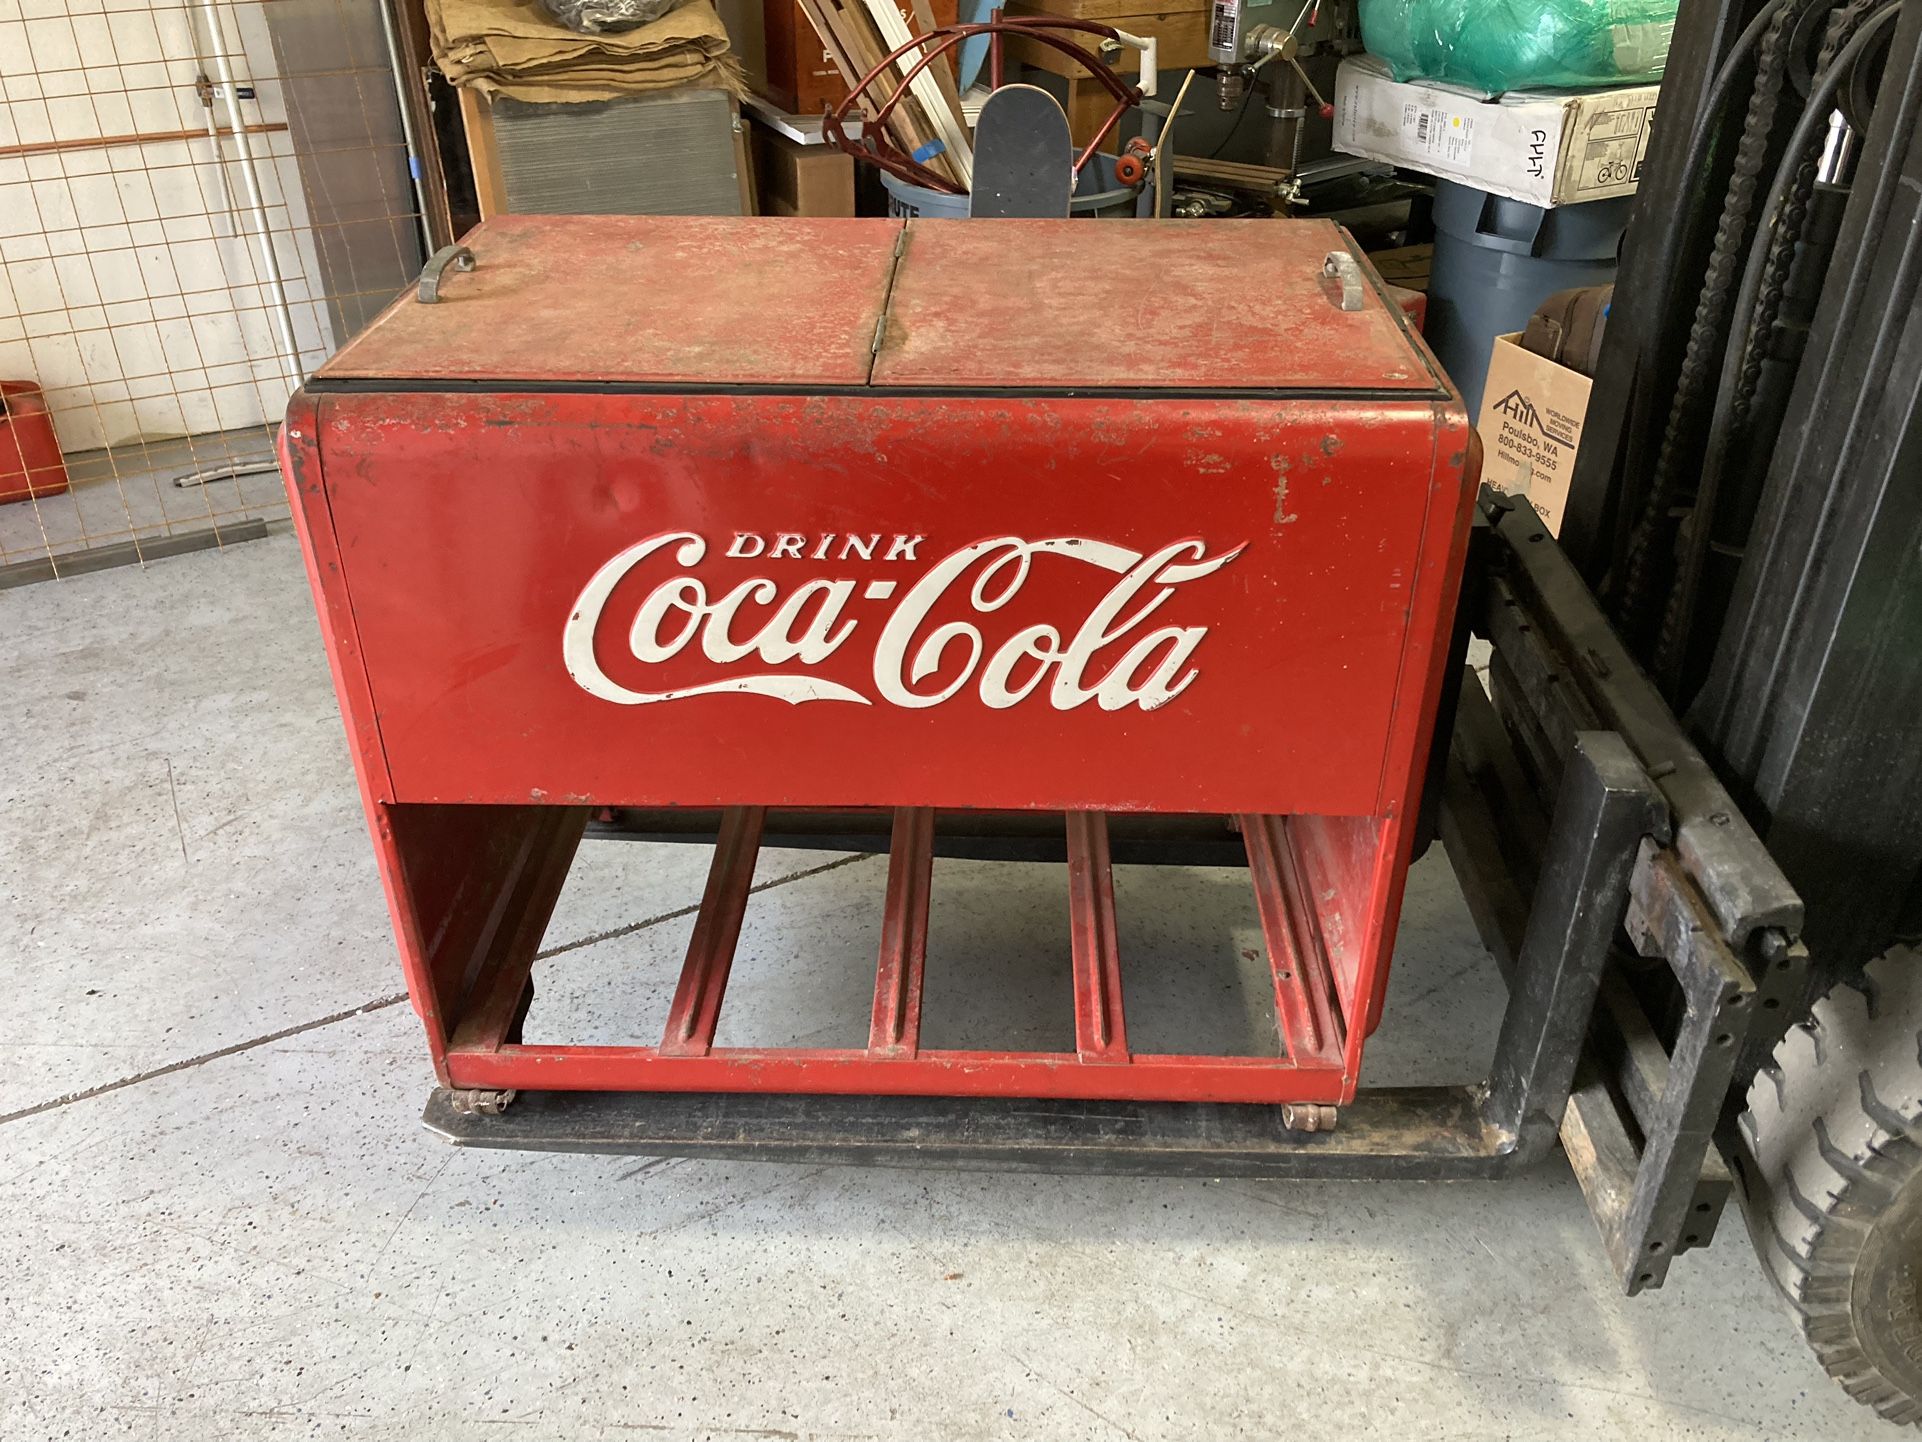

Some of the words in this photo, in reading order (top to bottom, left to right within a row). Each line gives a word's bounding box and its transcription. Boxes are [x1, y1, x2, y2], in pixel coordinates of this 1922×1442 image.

[1503, 398, 1534, 428] Hill
[1545, 407, 1580, 430] WORLDWIDE
[1549, 418, 1573, 434] MOVING
[1502, 421, 1540, 450] Poulsbo,
[1543, 441, 1558, 458] WA
[1545, 425, 1574, 443] SERVICES
[1497, 433, 1558, 471] 800-833-9555
[726, 532, 927, 561] DRINK
[562, 530, 1250, 711] Coca-Cola
